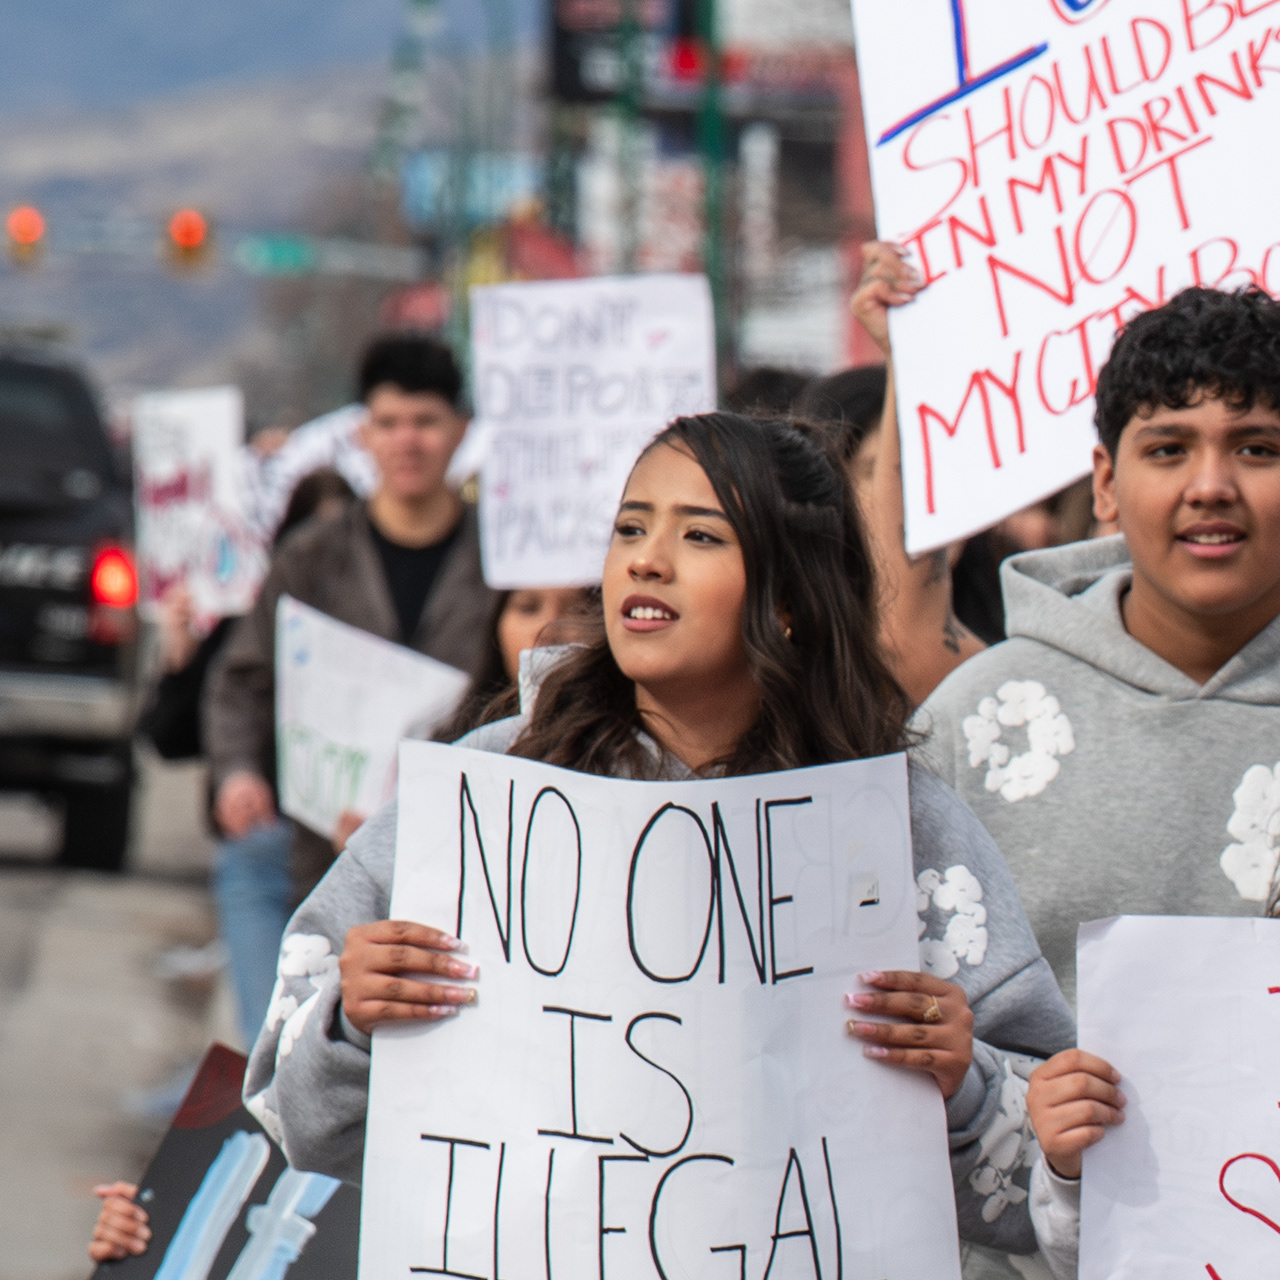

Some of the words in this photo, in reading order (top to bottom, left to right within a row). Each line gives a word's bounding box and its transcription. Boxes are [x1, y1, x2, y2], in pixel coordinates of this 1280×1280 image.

[900, 16, 1172, 232] SHOULD
[1180, 0, 1279, 52] B
[899, 194, 997, 288] IN
[1008, 134, 1089, 234] MY
[987, 135, 1214, 338] NOT
[917, 350, 1027, 514] MY
[456, 771, 581, 977] NO
[627, 795, 814, 985] ONE
[537, 1005, 693, 1158] IS
